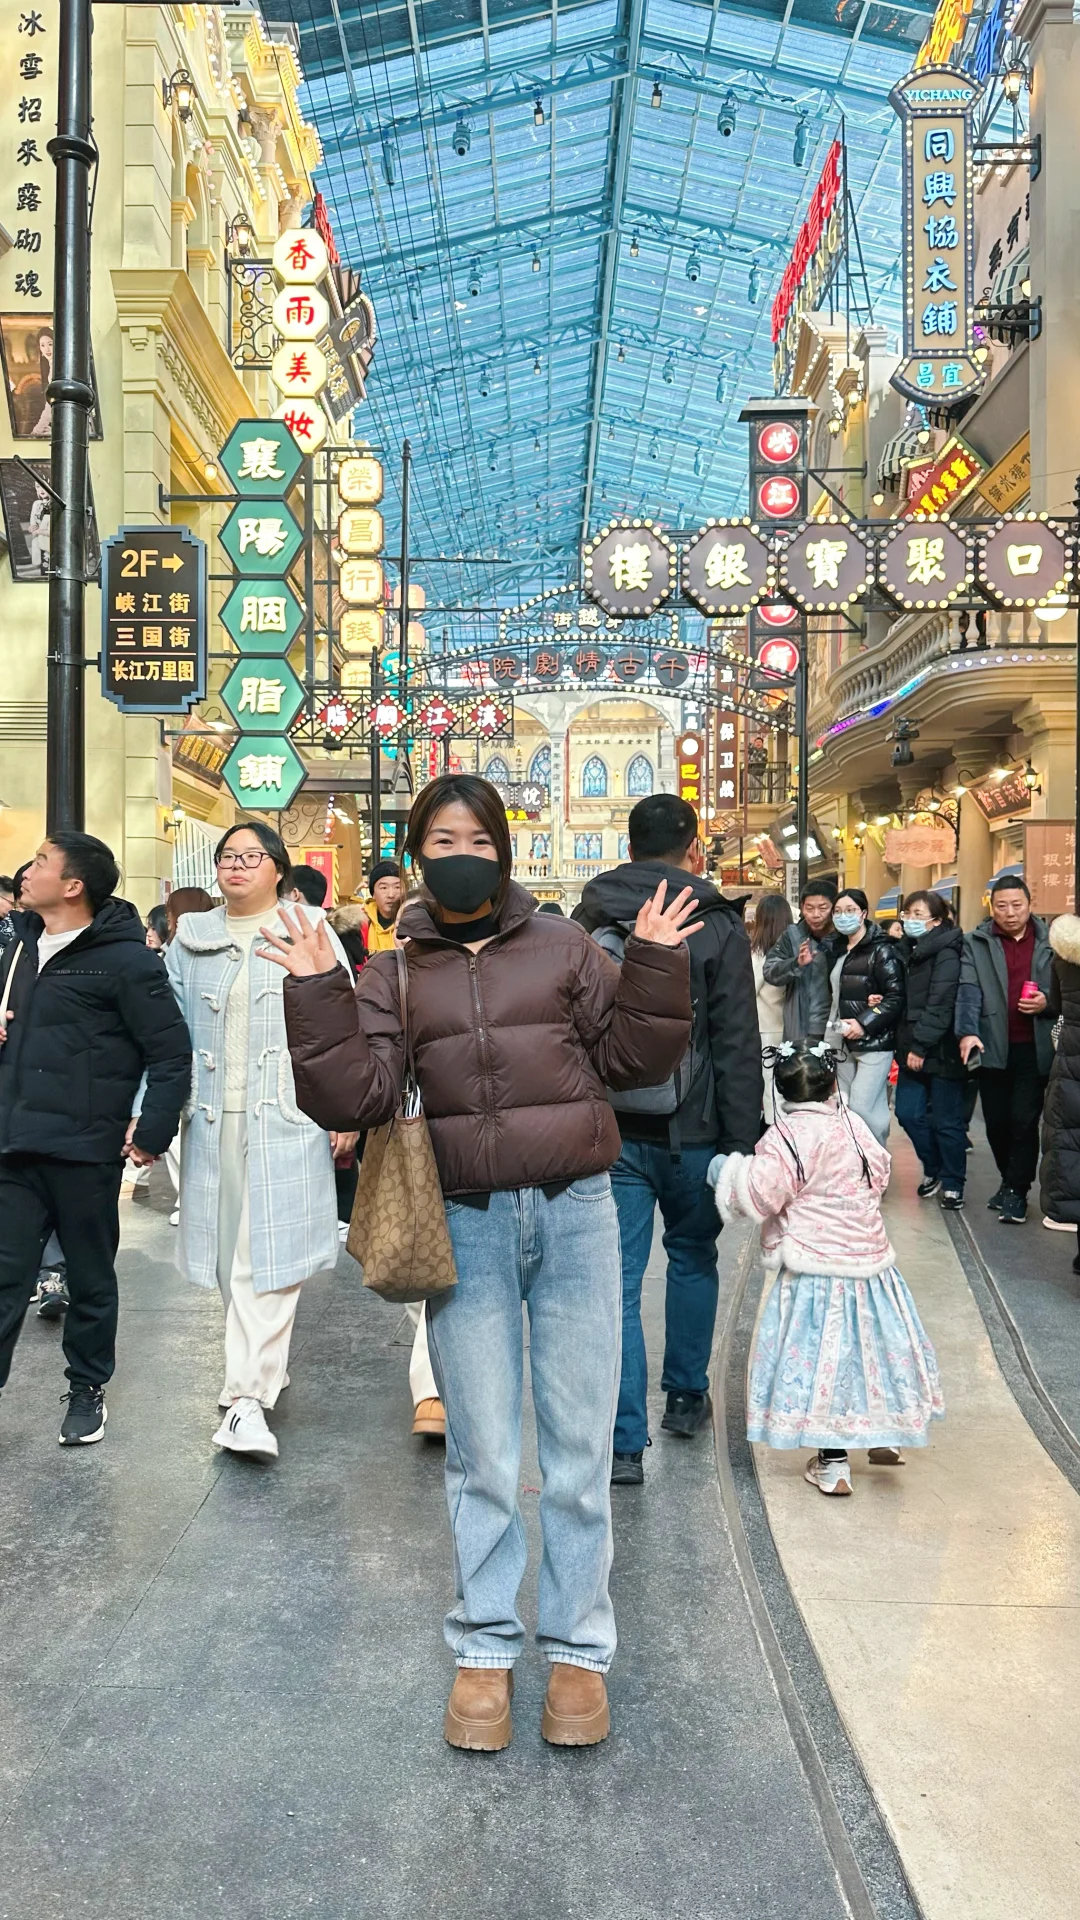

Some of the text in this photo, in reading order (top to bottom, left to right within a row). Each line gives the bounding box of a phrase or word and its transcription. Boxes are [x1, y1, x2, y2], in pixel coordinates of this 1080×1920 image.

[905, 89, 972, 102] YICHANG
[120, 550, 159, 578] 2F
[115, 592, 191, 614] 峡江街
[237, 437, 288, 790] 襄陽胭脂鋪
[115, 626, 191, 648] 三国街
[112, 659, 195, 682] 长江万里图
